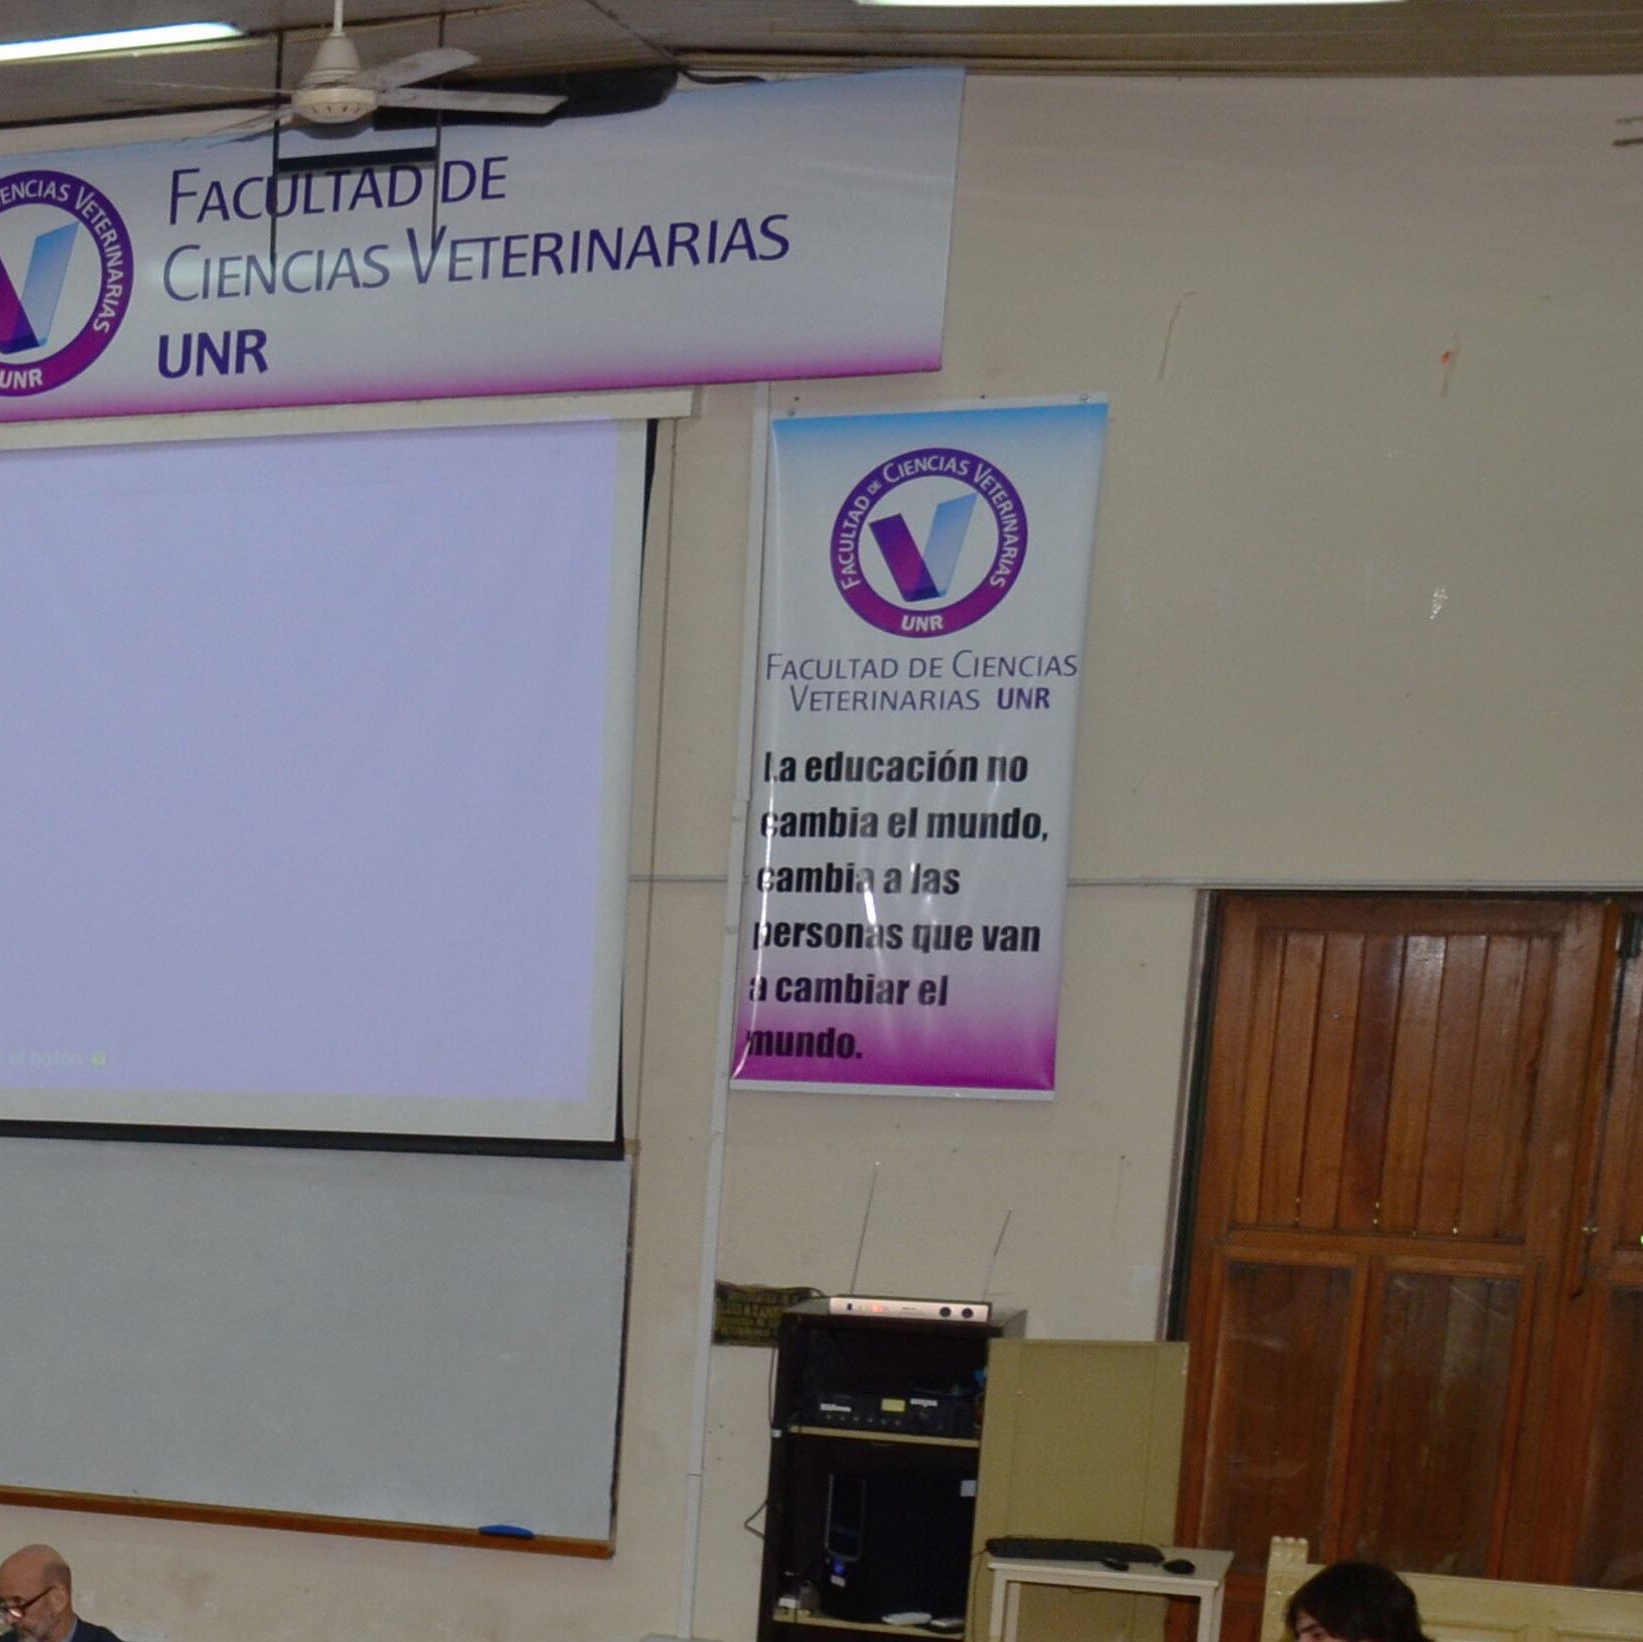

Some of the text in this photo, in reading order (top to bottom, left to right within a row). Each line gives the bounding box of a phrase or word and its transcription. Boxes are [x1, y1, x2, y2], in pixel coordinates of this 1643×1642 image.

[169, 156, 509, 226] FACULTAD DE
[75, 186, 125, 333] VETERINARIAS
[162, 214, 791, 301] CIENCIAS VETERINARIAS
[157, 329, 269, 379] UNR
[839, 495, 870, 591] FACULTAD
[882, 454, 971, 485] CIENCIAS
[974, 462, 1019, 590] VETERINARIAS
[901, 613, 944, 633] UNR
[766, 650, 1079, 681] FACULTAD DE CIENCIAS
[790, 684, 1051, 713] VETERINARIAS UNR
[764, 750, 1029, 783] La educación no
[760, 807, 1048, 842] cambia el mundo,
[757, 862, 961, 895] cambia a las
[753, 921, 1041, 954] personas que van
[749, 973, 949, 1007] a cambiar el
[746, 1027, 863, 1060] mundo.
